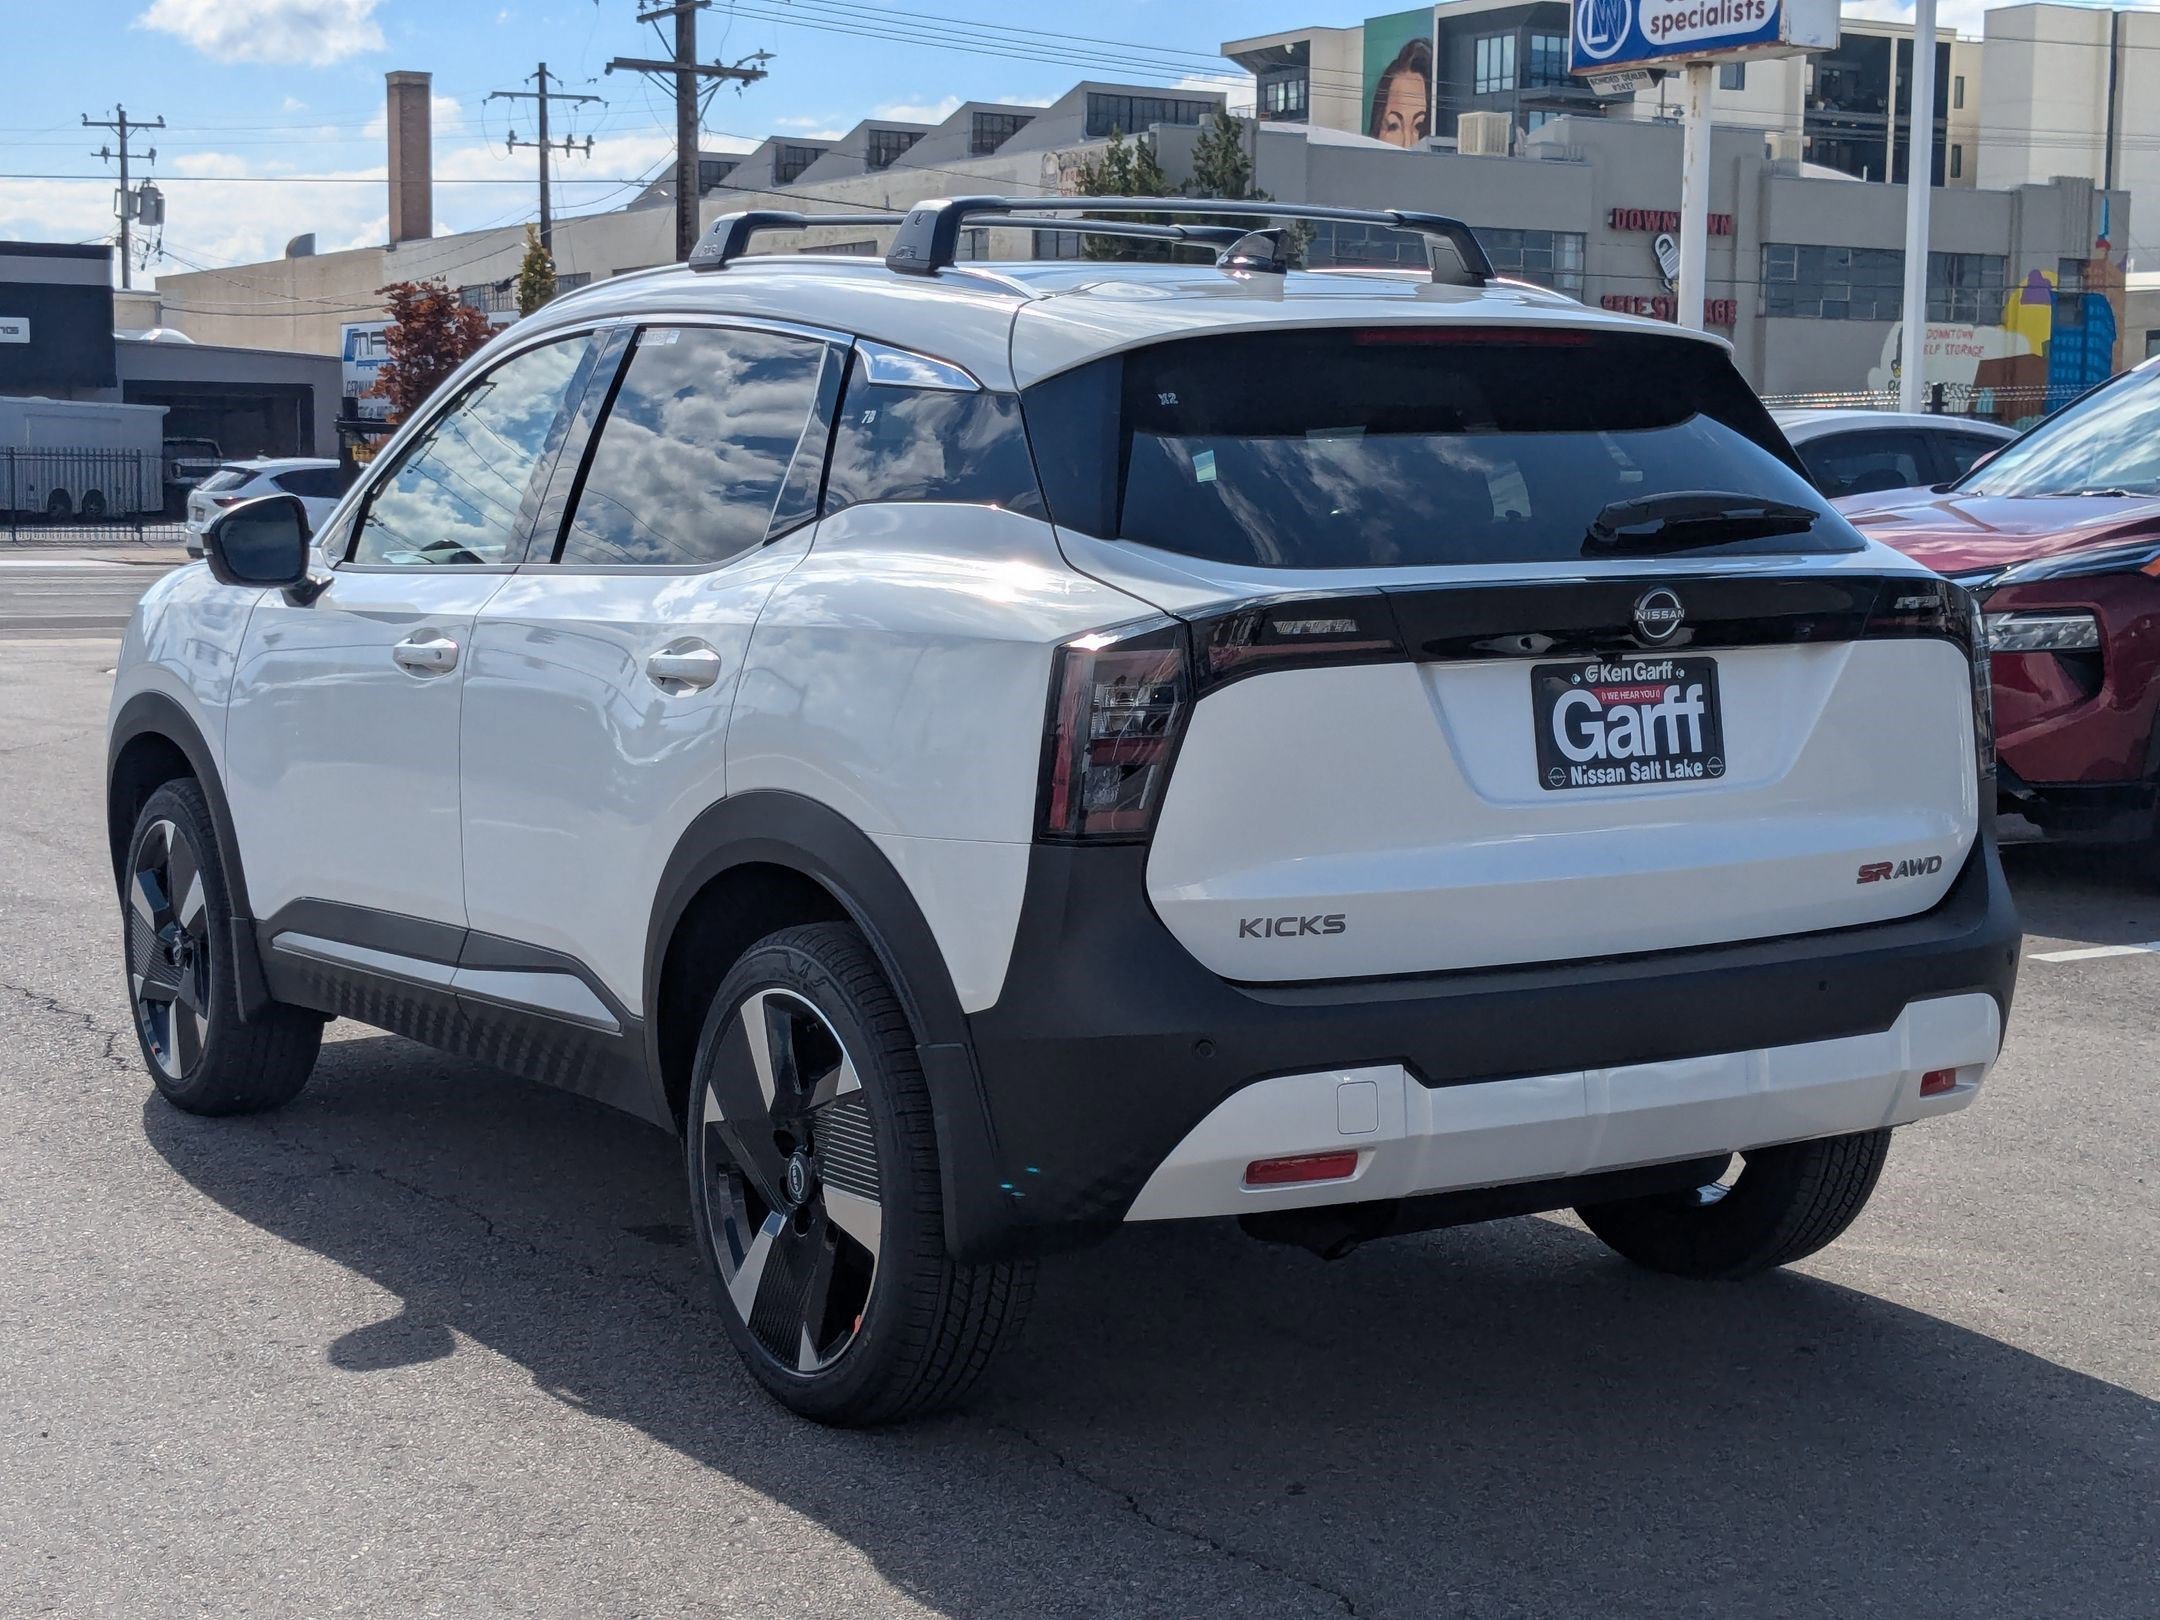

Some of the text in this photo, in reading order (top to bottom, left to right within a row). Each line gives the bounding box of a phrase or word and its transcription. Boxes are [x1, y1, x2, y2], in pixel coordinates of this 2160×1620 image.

[1650, 0, 1765, 40] specialists
[1612, 208, 1733, 236] DOWNWN
[1651, 297, 1737, 325] STAGE
[1926, 328, 1974, 341] DOWNTOWN
[1635, 608, 1685, 620] NISSAN
[1600, 663, 1632, 683] Ken
[1633, 661, 1673, 681] Garff
[1607, 689, 1655, 700] WE HEAR YOU
[1552, 683, 1705, 762] Garff
[1570, 758, 1703, 786] Nissan Salt Lake
[1856, 855, 1942, 884] SR AWD
[1239, 913, 1346, 938] KICKS
